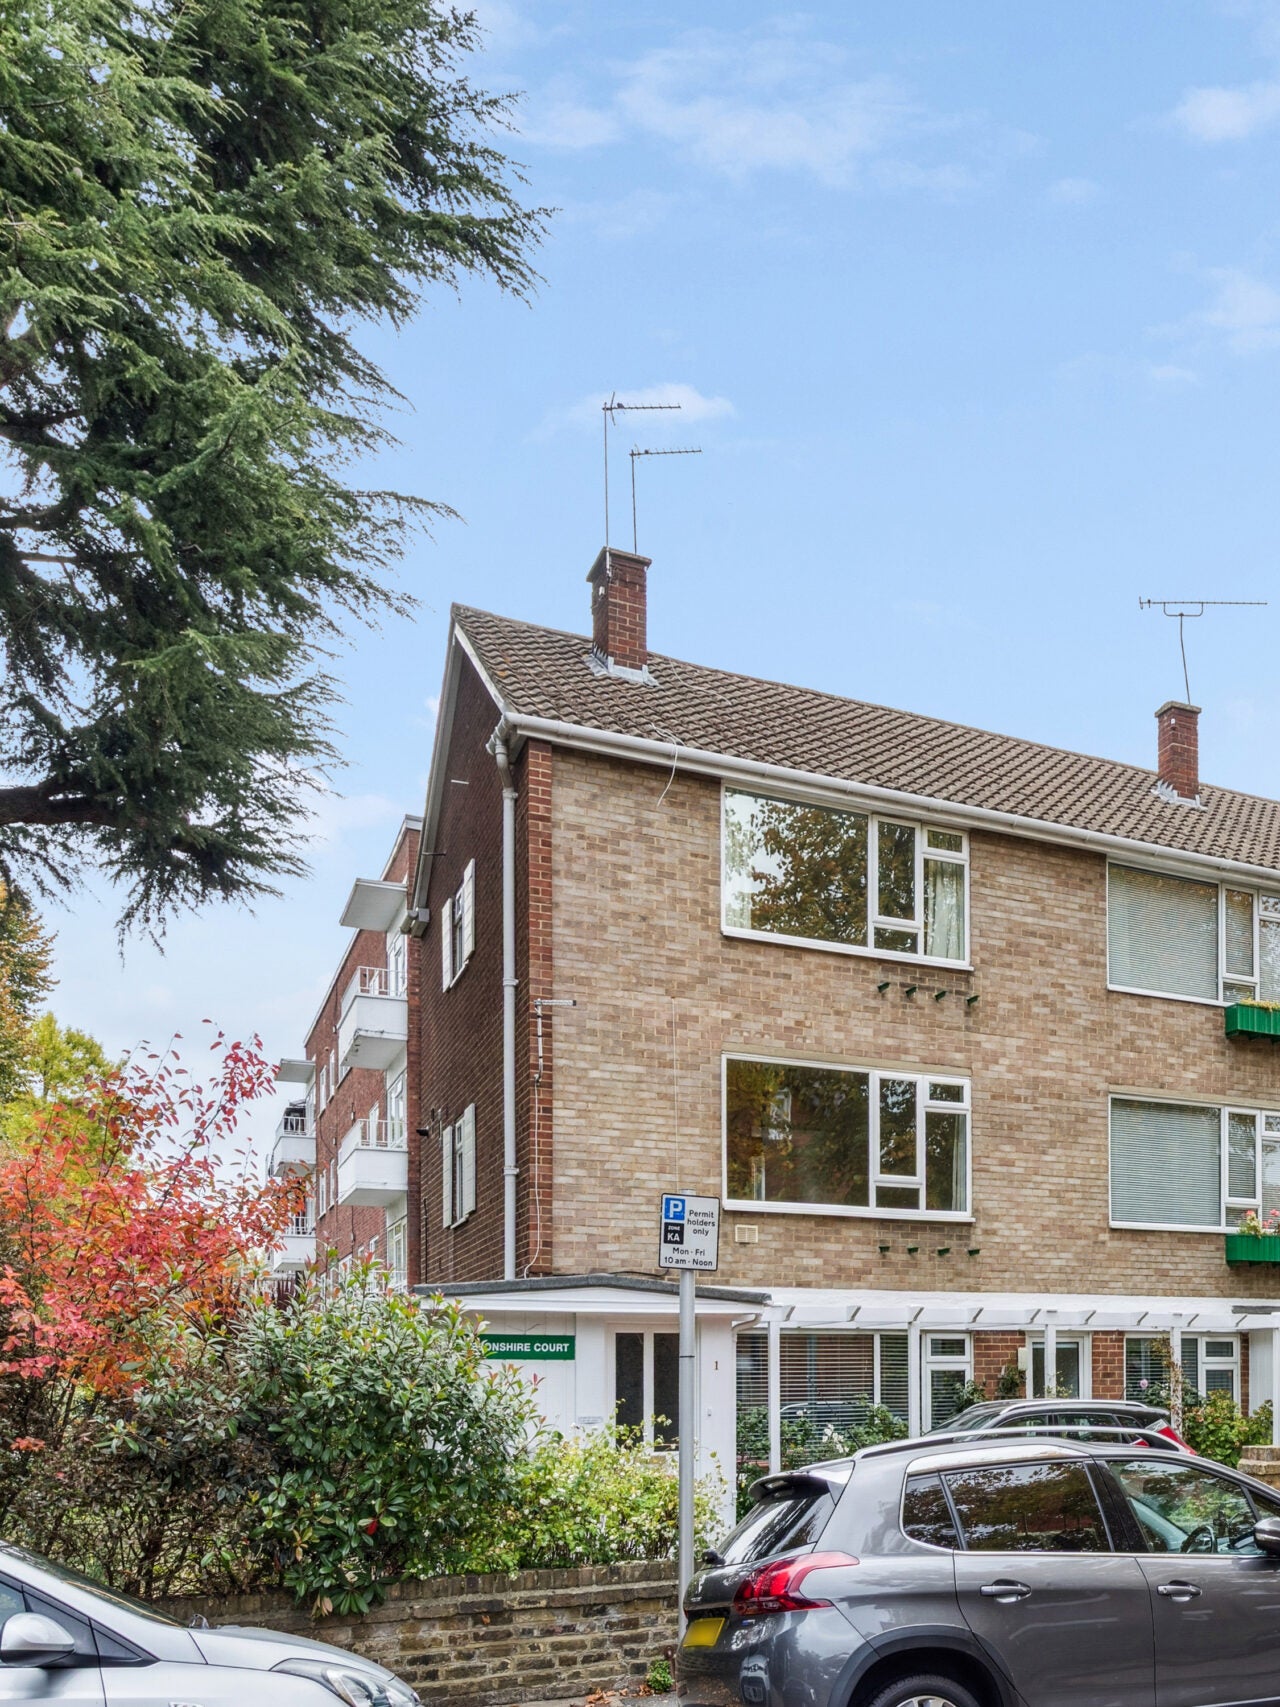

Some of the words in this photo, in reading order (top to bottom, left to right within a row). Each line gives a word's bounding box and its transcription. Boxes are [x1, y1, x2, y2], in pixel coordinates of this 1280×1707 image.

[669, 1200, 683, 1218] P
[689, 1209, 714, 1219] Permit
[687, 1218, 716, 1227] holders
[692, 1227, 709, 1236] only
[667, 1232, 680, 1241] KA
[672, 1247, 689, 1255] Mon
[695, 1248, 705, 1256] Fri
[692, 1258, 713, 1267] Noon
[484, 1342, 531, 1352] ONSHIRE
[533, 1343, 570, 1352] COURT
